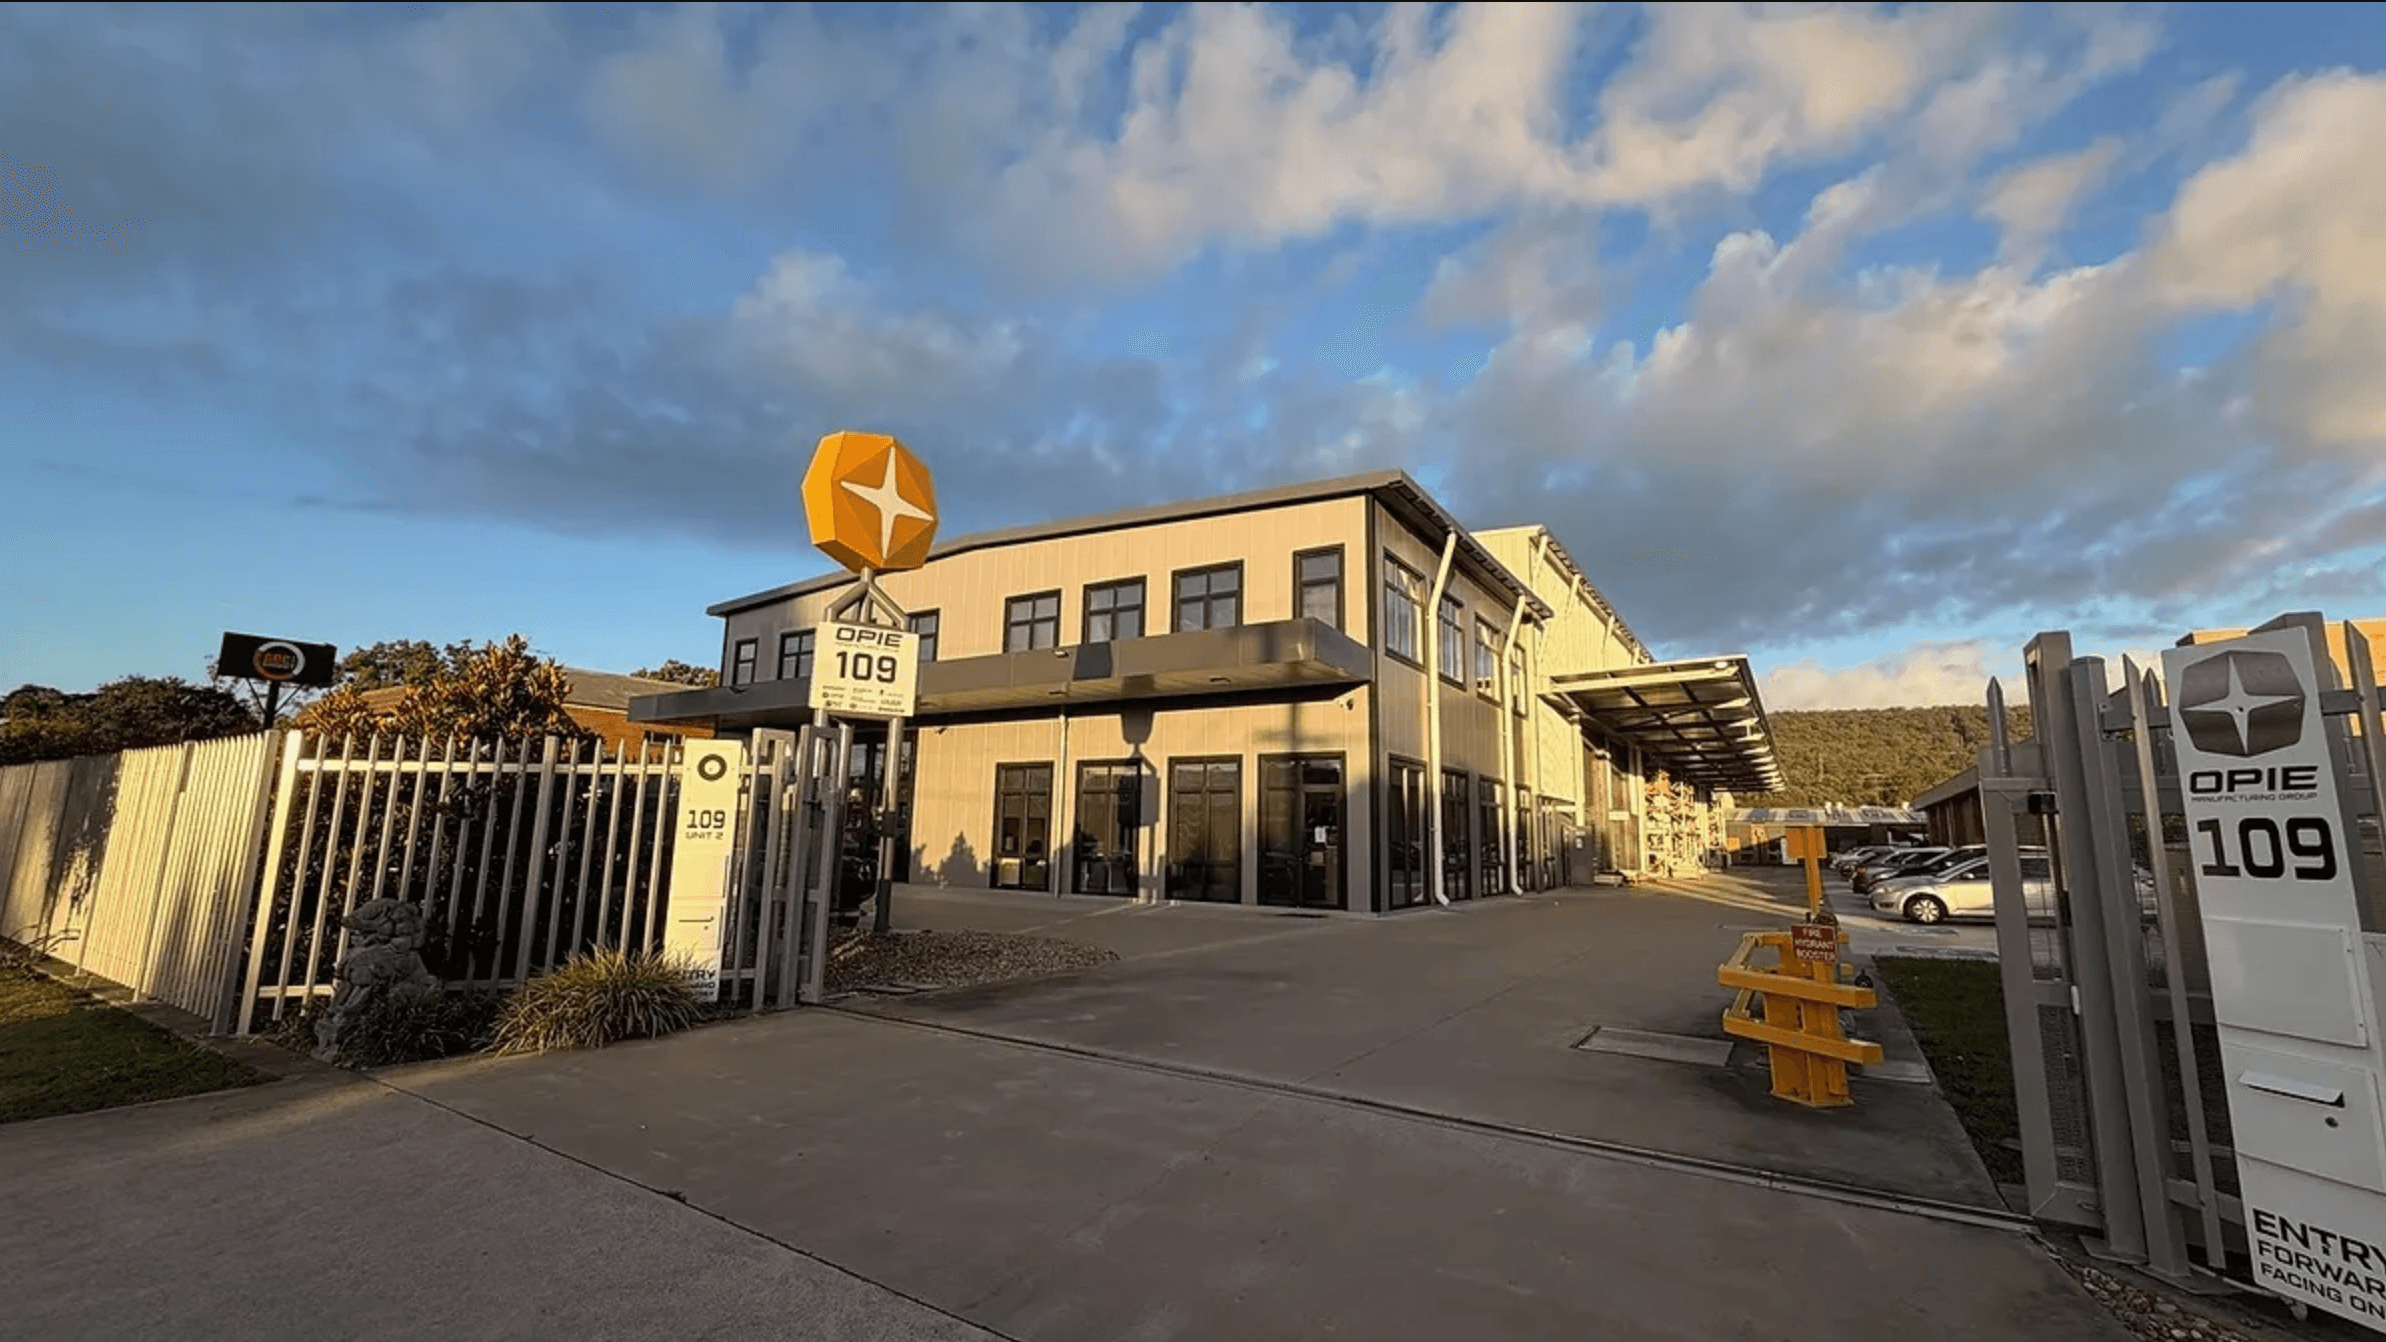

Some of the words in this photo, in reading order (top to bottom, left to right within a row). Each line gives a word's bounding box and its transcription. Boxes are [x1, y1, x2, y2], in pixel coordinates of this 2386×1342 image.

[836, 627, 903, 648] OPIE
[836, 651, 898, 684] 109
[2190, 765, 2318, 794] OPIE
[2190, 792, 2276, 803] MANUFACTURING
[2278, 791, 2318, 801] GROUP
[686, 809, 726, 829] 109
[685, 831, 712, 840] UNIT
[714, 831, 724, 840] 2
[2197, 817, 2338, 881] 109
[2261, 1262, 2343, 1304] FACING
